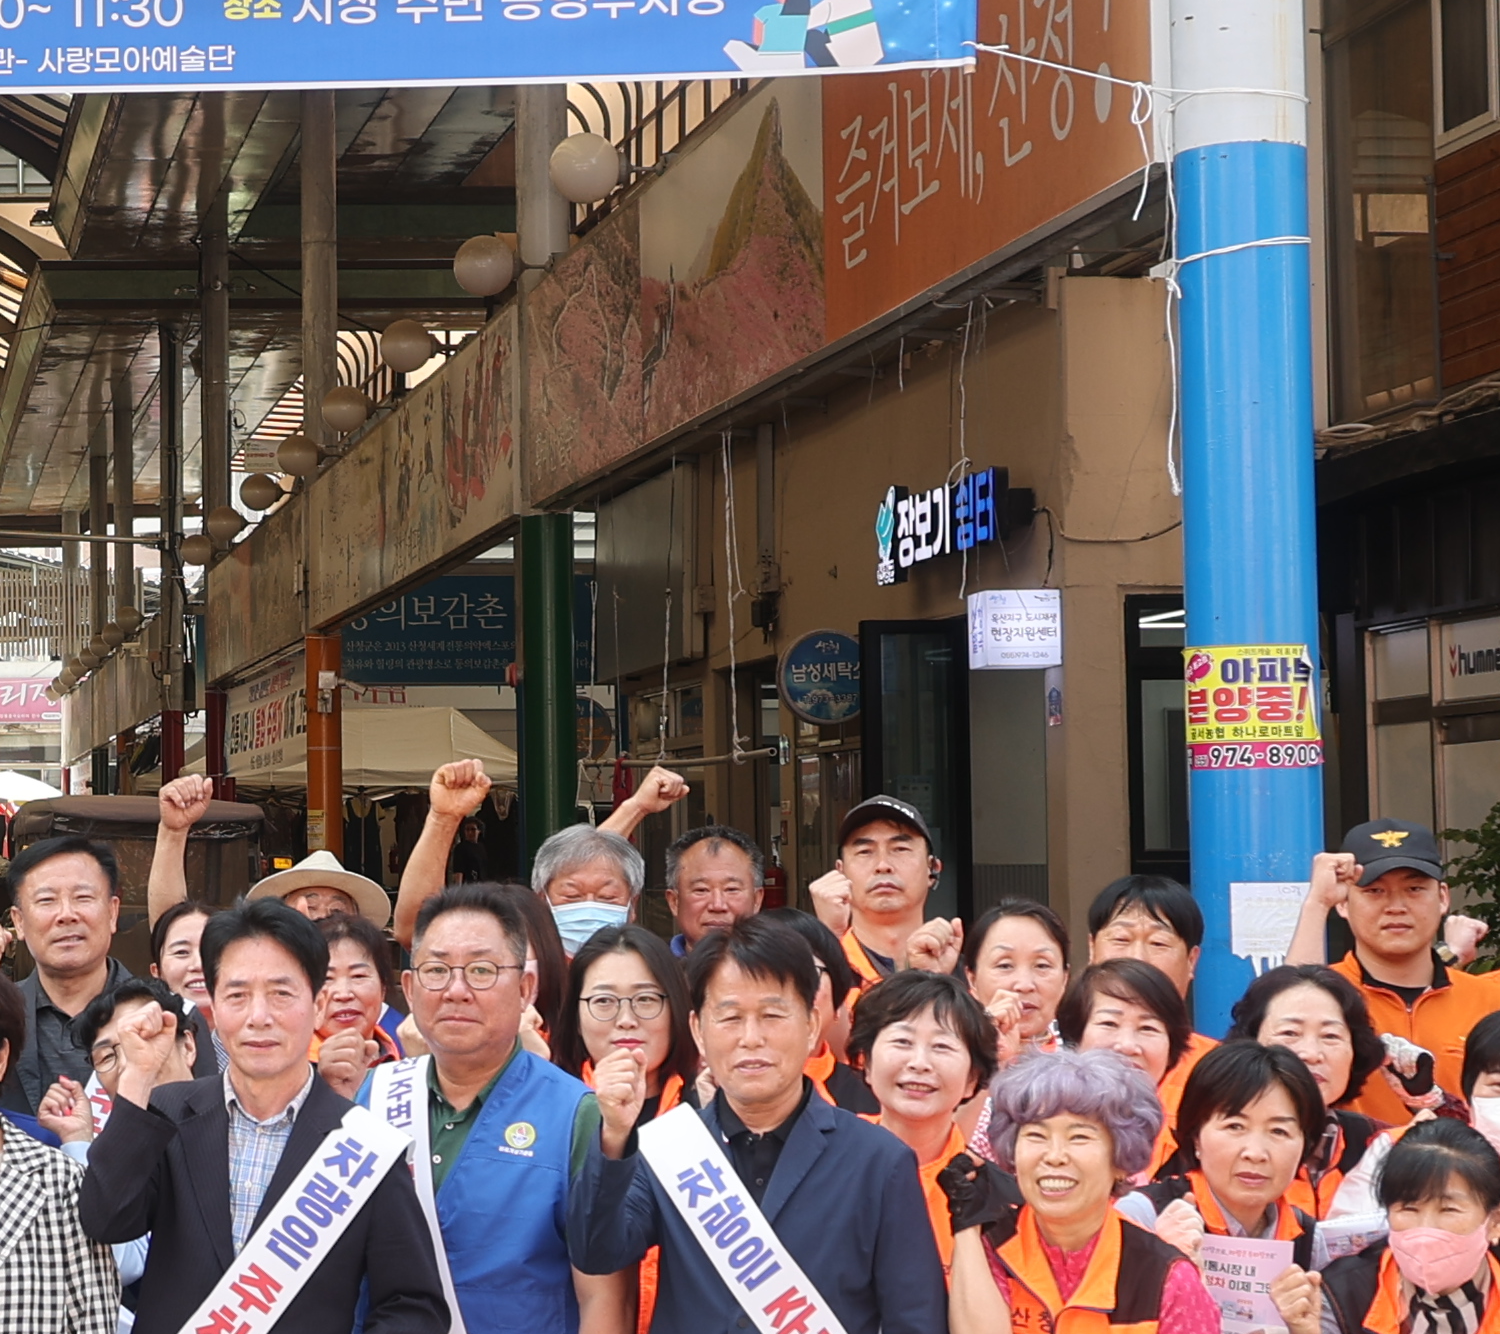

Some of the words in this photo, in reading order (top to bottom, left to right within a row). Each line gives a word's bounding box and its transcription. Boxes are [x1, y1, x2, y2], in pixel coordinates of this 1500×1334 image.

[37, 43, 235, 74] 사랑모아예술단
[897, 483, 951, 568] 장보기
[1210, 745, 1320, 767] 974-8900
[267, 1135, 377, 1273] 차량은
[677, 1158, 782, 1293] 차량은
[1205, 1275, 1225, 1288] 정차
[1228, 1280, 1251, 1293] 이제
